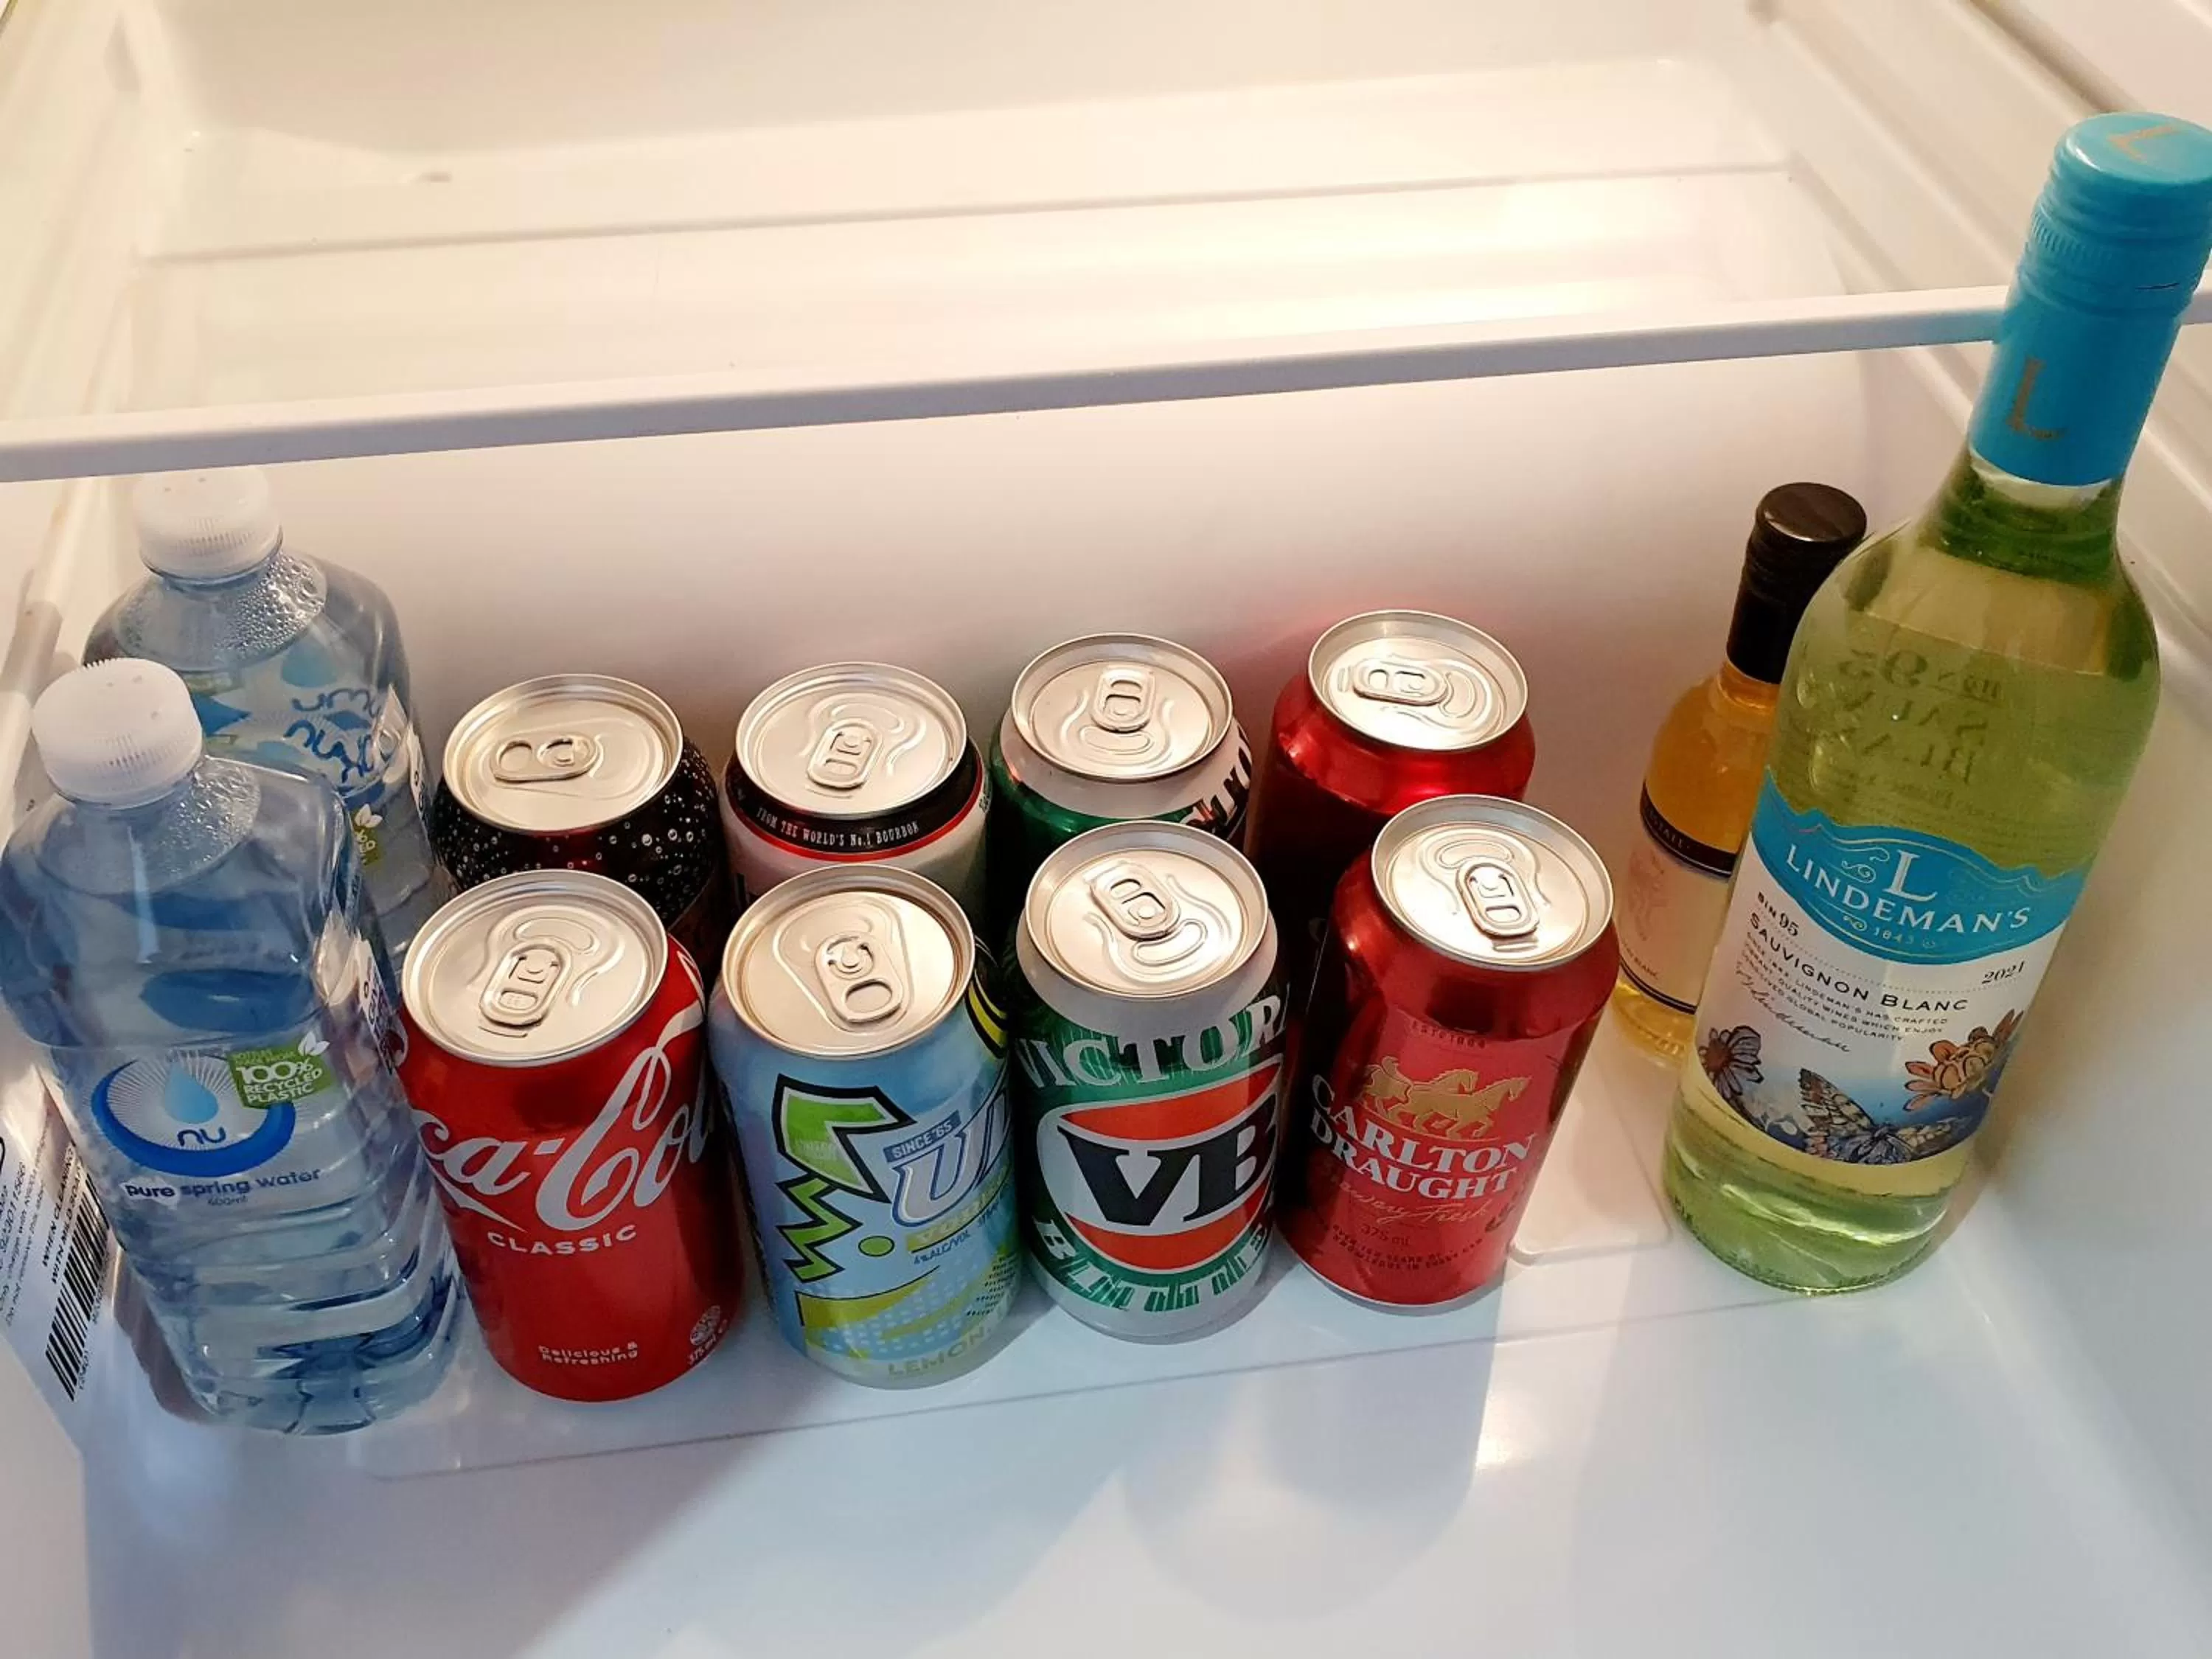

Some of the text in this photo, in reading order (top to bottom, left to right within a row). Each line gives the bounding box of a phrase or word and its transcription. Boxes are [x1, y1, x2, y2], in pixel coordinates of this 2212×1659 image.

[2005, 355, 2069, 439] L
[756, 807, 778, 829] FROM
[780, 820, 797, 838] THE
[802, 827, 845, 846] WORLD'S
[876, 821, 920, 845] BOURBON
[1786, 844, 2032, 934] LINDEMAN'S
[1884, 849, 1938, 902] L
[1757, 891, 1800, 936] BIN 95
[1749, 911, 1869, 1001] SAUVIGNON
[1881, 993, 1968, 1011] BLANC
[1981, 960, 2025, 985] 2021
[1778, 978, 1819, 1006] QUALITY
[1822, 1004, 1858, 1023] WINES
[1862, 1019, 1900, 1032] WHICH
[1796, 979, 1862, 1014] LINDEMAN'S
[1866, 1009, 1890, 1020] HAS
[1894, 1015, 1947, 1025] CRAFTED
[1831, 1020, 1904, 1041] POPULARITY
[235, 1058, 314, 1084] 100%
[243, 1068, 322, 1093] RECYCLED
[247, 1083, 314, 1103] PLASTIC
[178, 1126, 226, 1146] nu
[1312, 1074, 1537, 1173] CARLTON
[891, 1134, 930, 1159] SINCE
[1057, 1093, 1277, 1226] VB
[1310, 1108, 1517, 1199] DRAUGHT
[126, 1168, 321, 1197] pure spring water
[42, 1220, 57, 1267] WHEN
[487, 1224, 638, 1256] CLASSIC
[888, 1328, 984, 1377] LEMON
